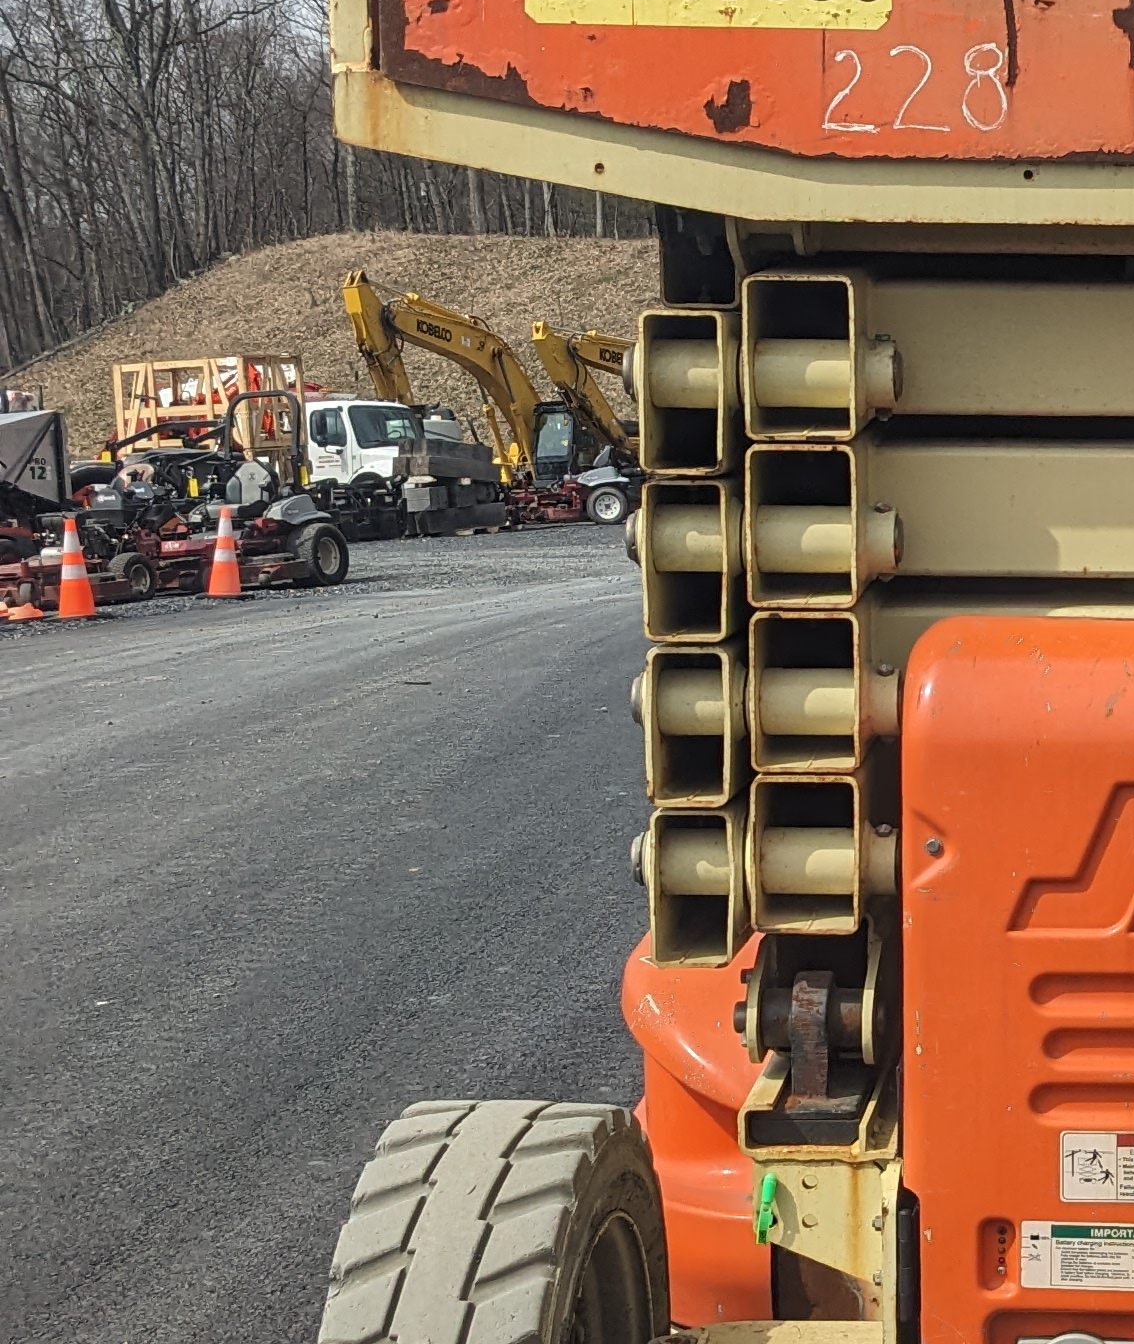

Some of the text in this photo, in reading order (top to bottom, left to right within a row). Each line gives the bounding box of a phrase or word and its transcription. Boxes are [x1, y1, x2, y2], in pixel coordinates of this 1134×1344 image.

[821, 42, 1009, 134] 228
[416, 319, 452, 343] KOBELCO
[599, 348, 623, 365] KOBE
